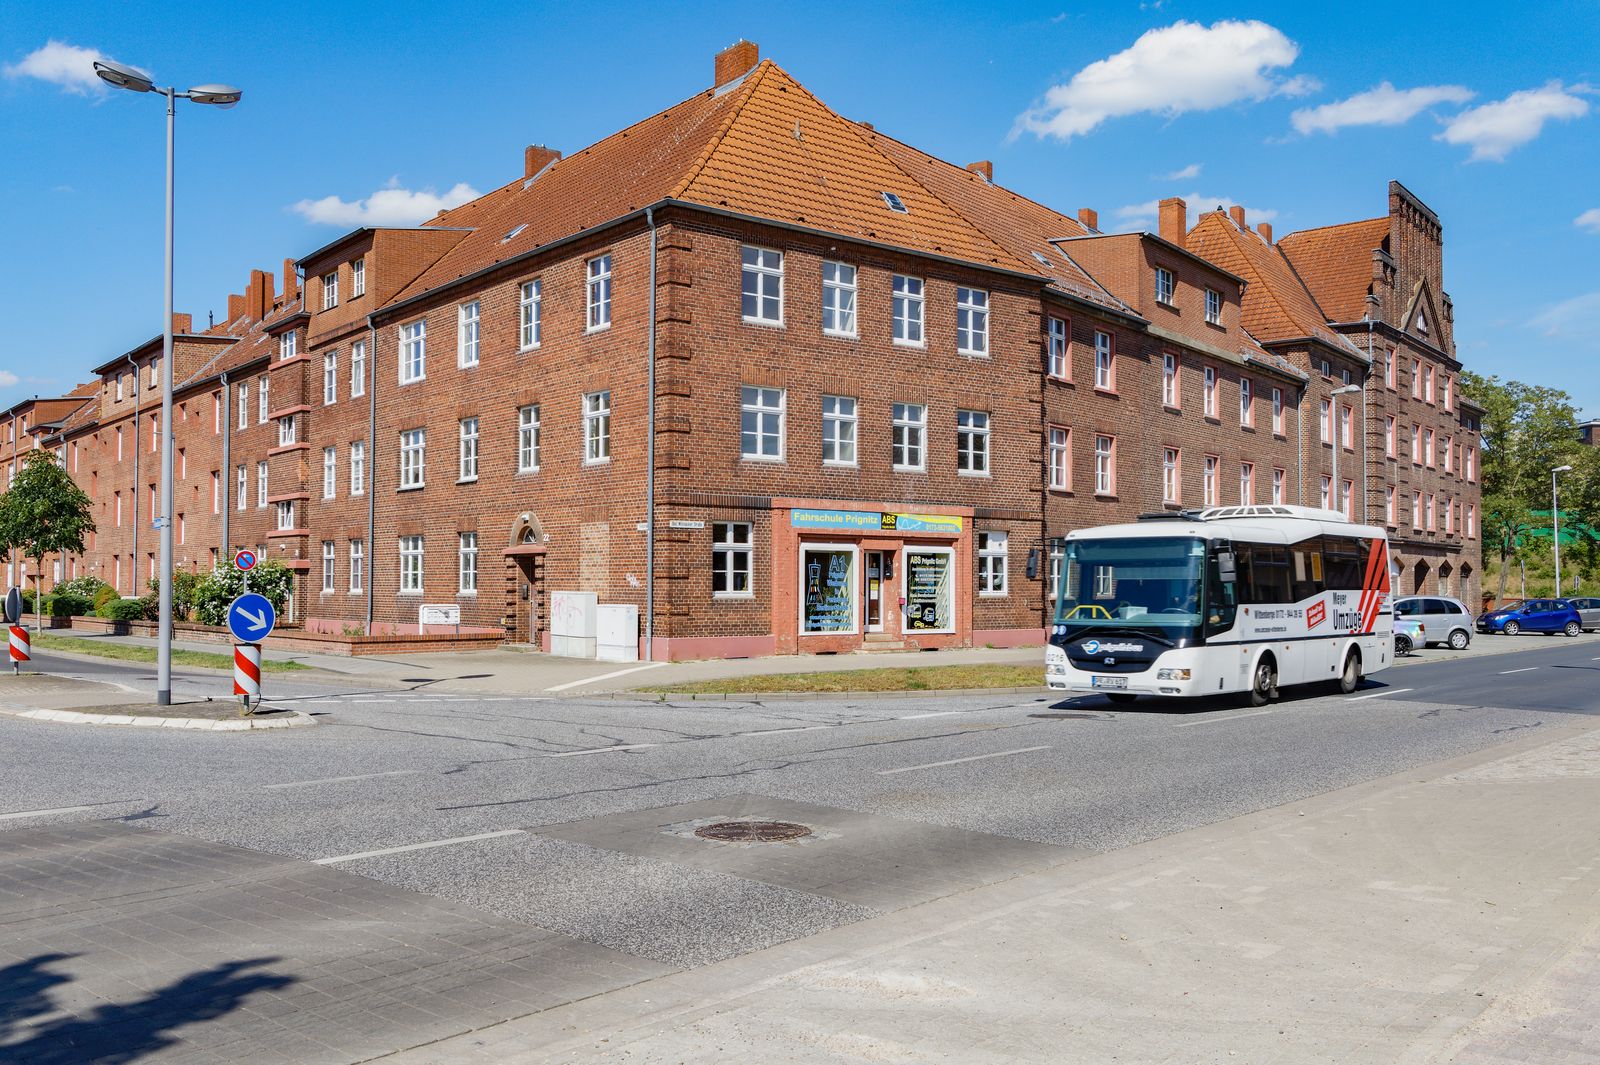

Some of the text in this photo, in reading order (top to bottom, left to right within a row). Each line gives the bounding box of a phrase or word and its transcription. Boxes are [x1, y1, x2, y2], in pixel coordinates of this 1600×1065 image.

[794, 512, 878, 525] Fahrschule Prignitz
[881, 515, 895, 524] ABS
[543, 533, 550, 541] 22
[910, 555, 921, 564] ABS
[1333, 592, 1347, 606] Meyer
[1333, 608, 1362, 631] Umzüge
